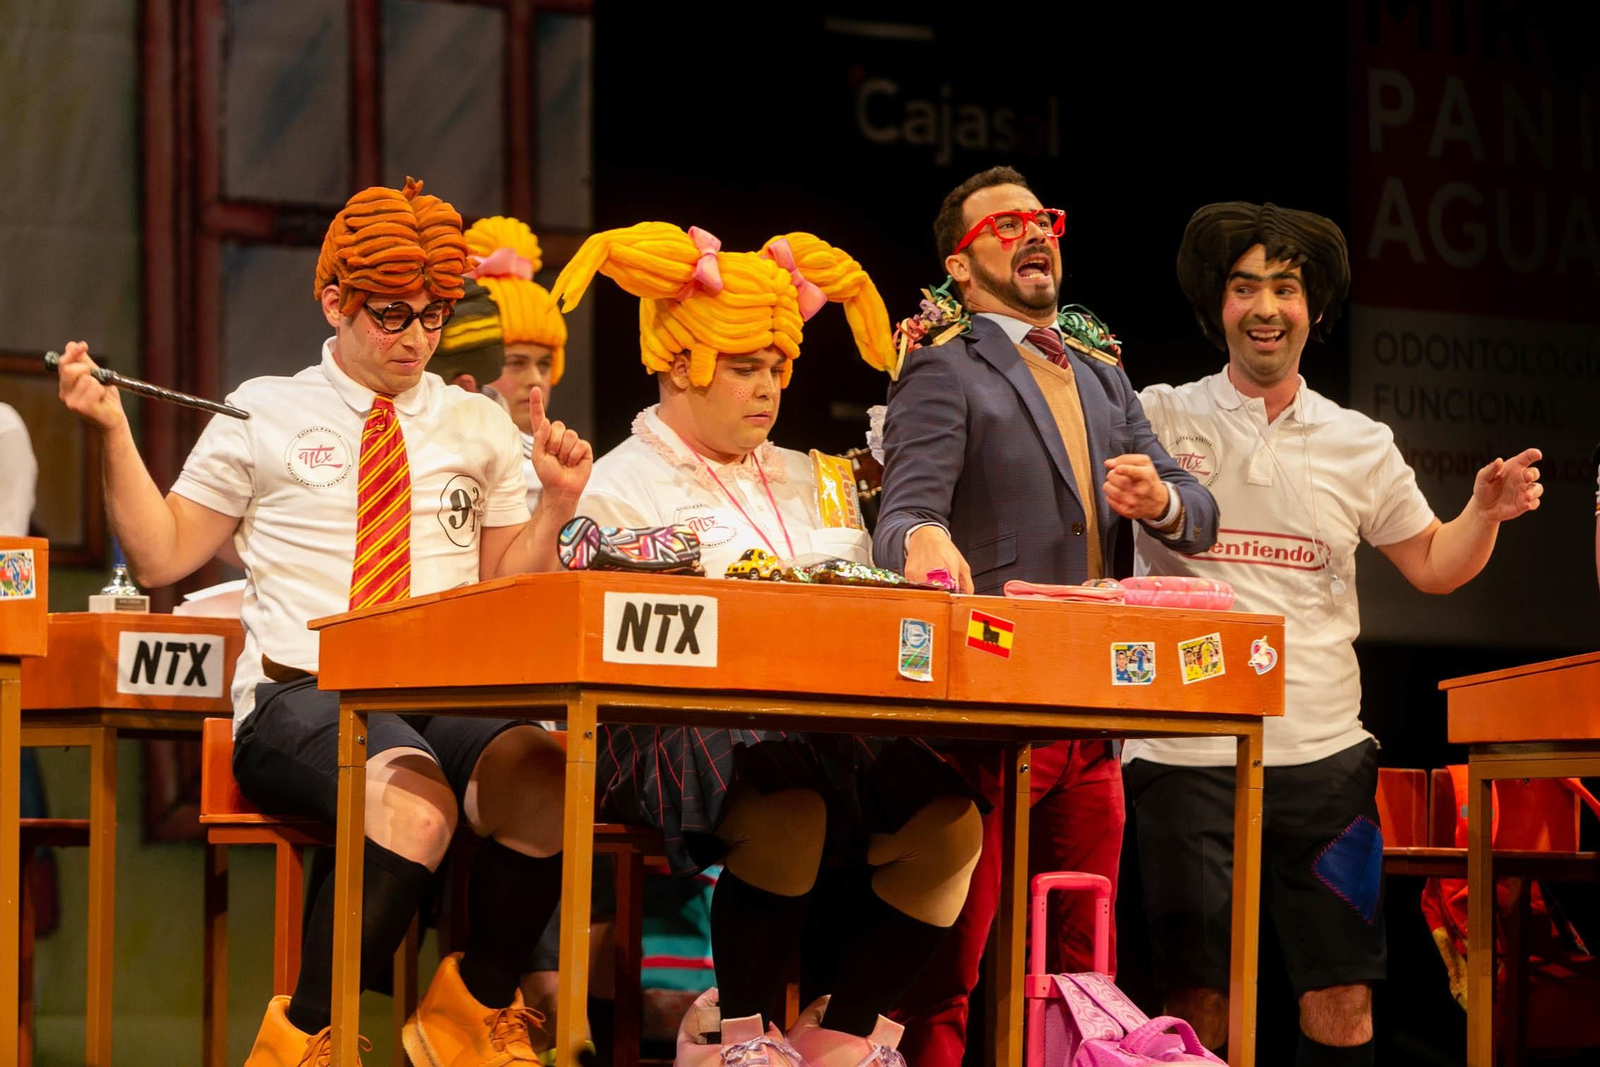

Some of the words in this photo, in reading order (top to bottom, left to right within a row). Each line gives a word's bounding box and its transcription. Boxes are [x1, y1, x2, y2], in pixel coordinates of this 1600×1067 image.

[854, 77, 1061, 166] Cajasol
[1373, 382, 1567, 430] FUNCIONAL
[616, 601, 705, 655] NTX
[130, 639, 212, 687] NTX
